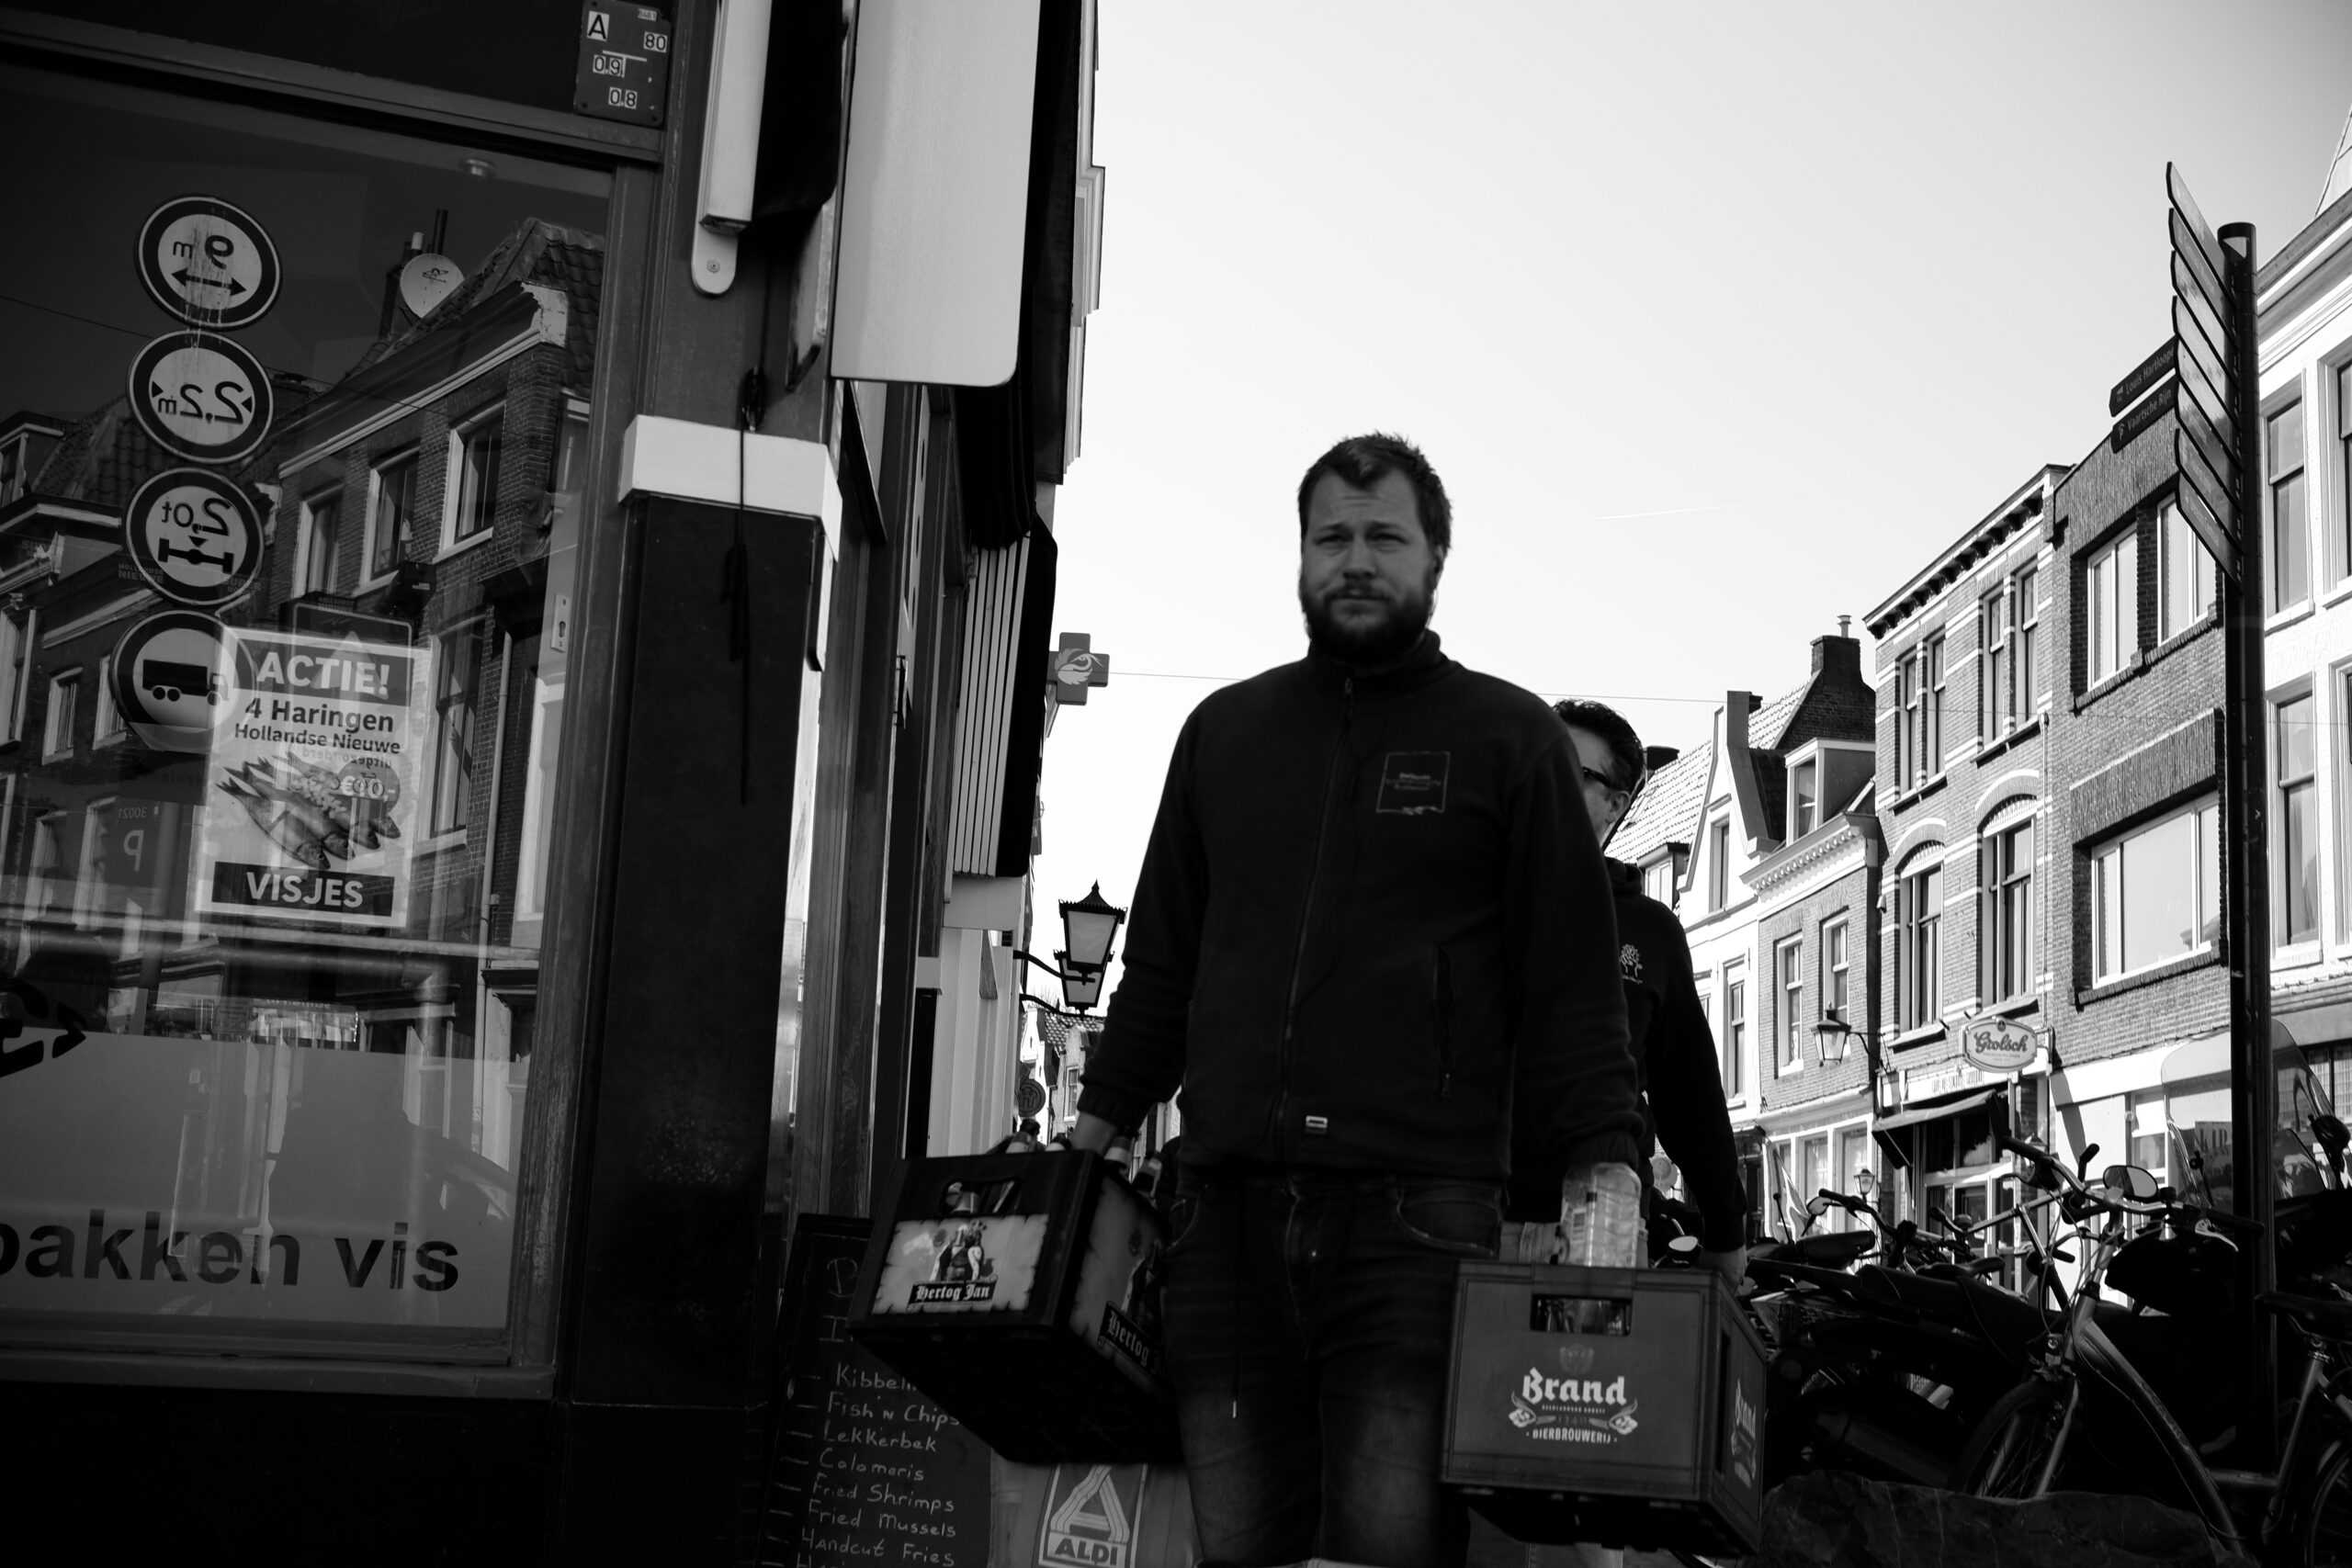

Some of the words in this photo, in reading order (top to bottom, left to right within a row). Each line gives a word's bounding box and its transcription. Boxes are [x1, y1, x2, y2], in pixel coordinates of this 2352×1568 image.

[588, 14, 606, 39] A
[645, 33, 666, 51] 80
[2125, 372, 2143, 395] Louis
[2127, 400, 2158, 431] Vaartsche
[2158, 389, 2172, 407] Rijn
[256, 650, 390, 695] ACTIE!
[244, 697, 262, 719] 4
[271, 700, 394, 734] Haringen
[234, 723, 327, 747] Hollandse
[333, 735, 401, 755] Nieuwe
[246, 871, 364, 908] VISJES
[1973, 1031, 2029, 1054] Grolsch
[334, 1222, 459, 1292] vis
[914, 1285, 963, 1302] Hertog
[962, 1282, 990, 1301] Jan
[1105, 1309, 1150, 1368] Hertog
[1521, 1366, 1627, 1406] Brand
[828, 1390, 873, 1418] Fish
[904, 1404, 960, 1431] Chips
[823, 1417, 937, 1451] Lekkerbek
[1532, 1427, 1611, 1445] BIERBROUWERIJ
[812, 1471, 858, 1500] Fried
[866, 1482, 955, 1515] Shrimps
[808, 1498, 862, 1529] Fried
[878, 1513, 956, 1538] Mussels
[902, 1542, 955, 1567] Fries
[1054, 1537, 1118, 1566] ALDI
